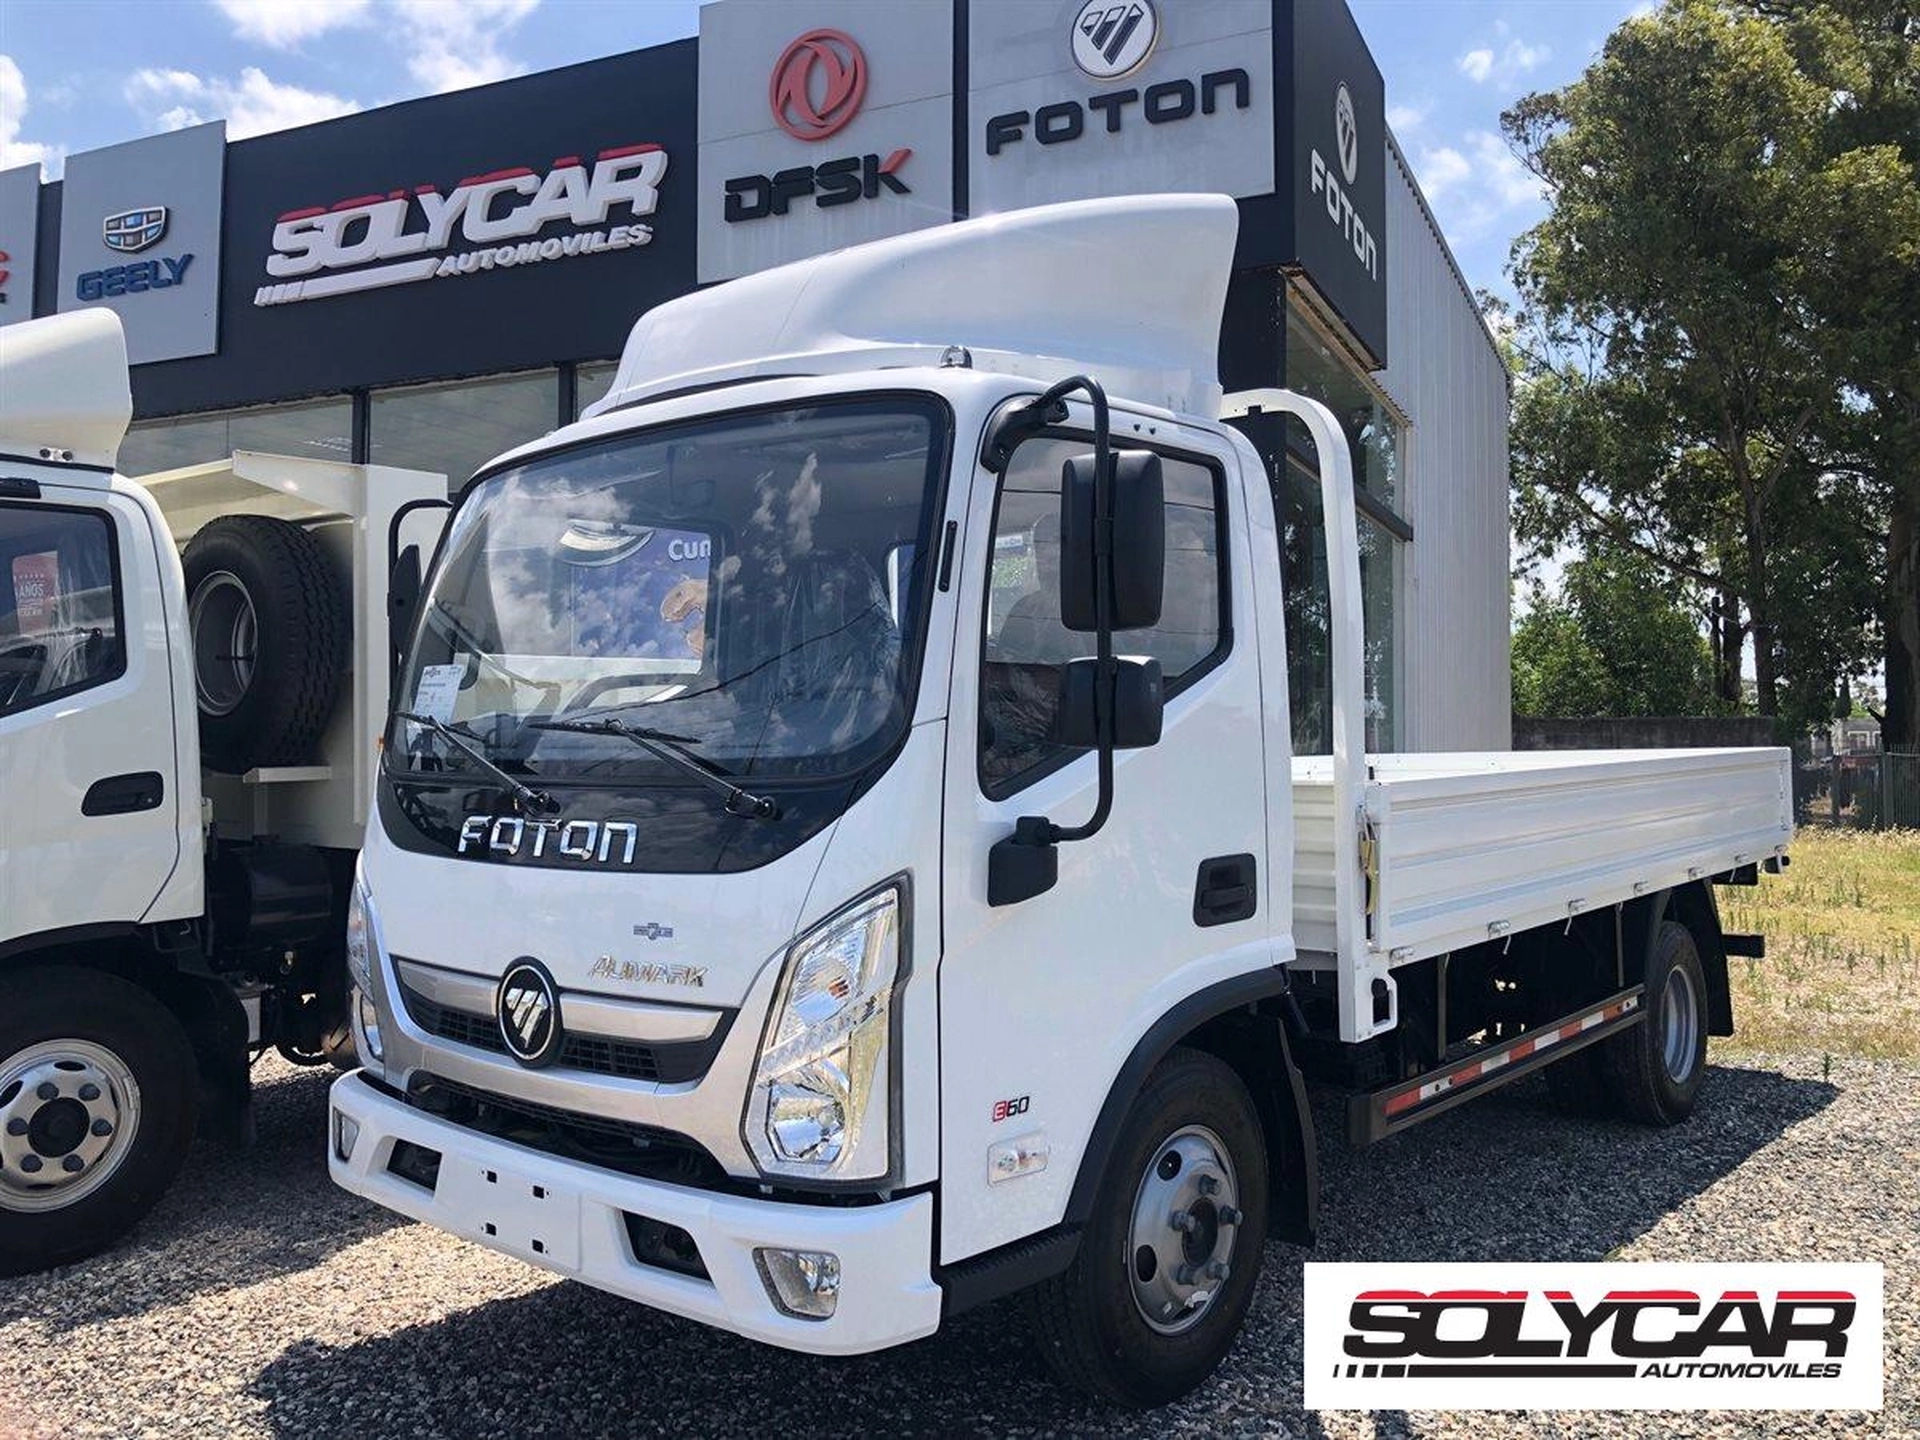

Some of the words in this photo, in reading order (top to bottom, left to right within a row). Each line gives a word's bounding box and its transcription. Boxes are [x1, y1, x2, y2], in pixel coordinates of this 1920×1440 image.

[986, 68, 1250, 156] FOTON
[266, 143, 668, 277] SOLYCAR
[724, 148, 912, 223] DFSK
[1311, 147, 1377, 282] FOTON
[76, 253, 194, 301] GEELY
[436, 223, 654, 277] AUTOMOVILES
[458, 816, 637, 863] FOTON
[589, 955, 708, 987] AUMARK
